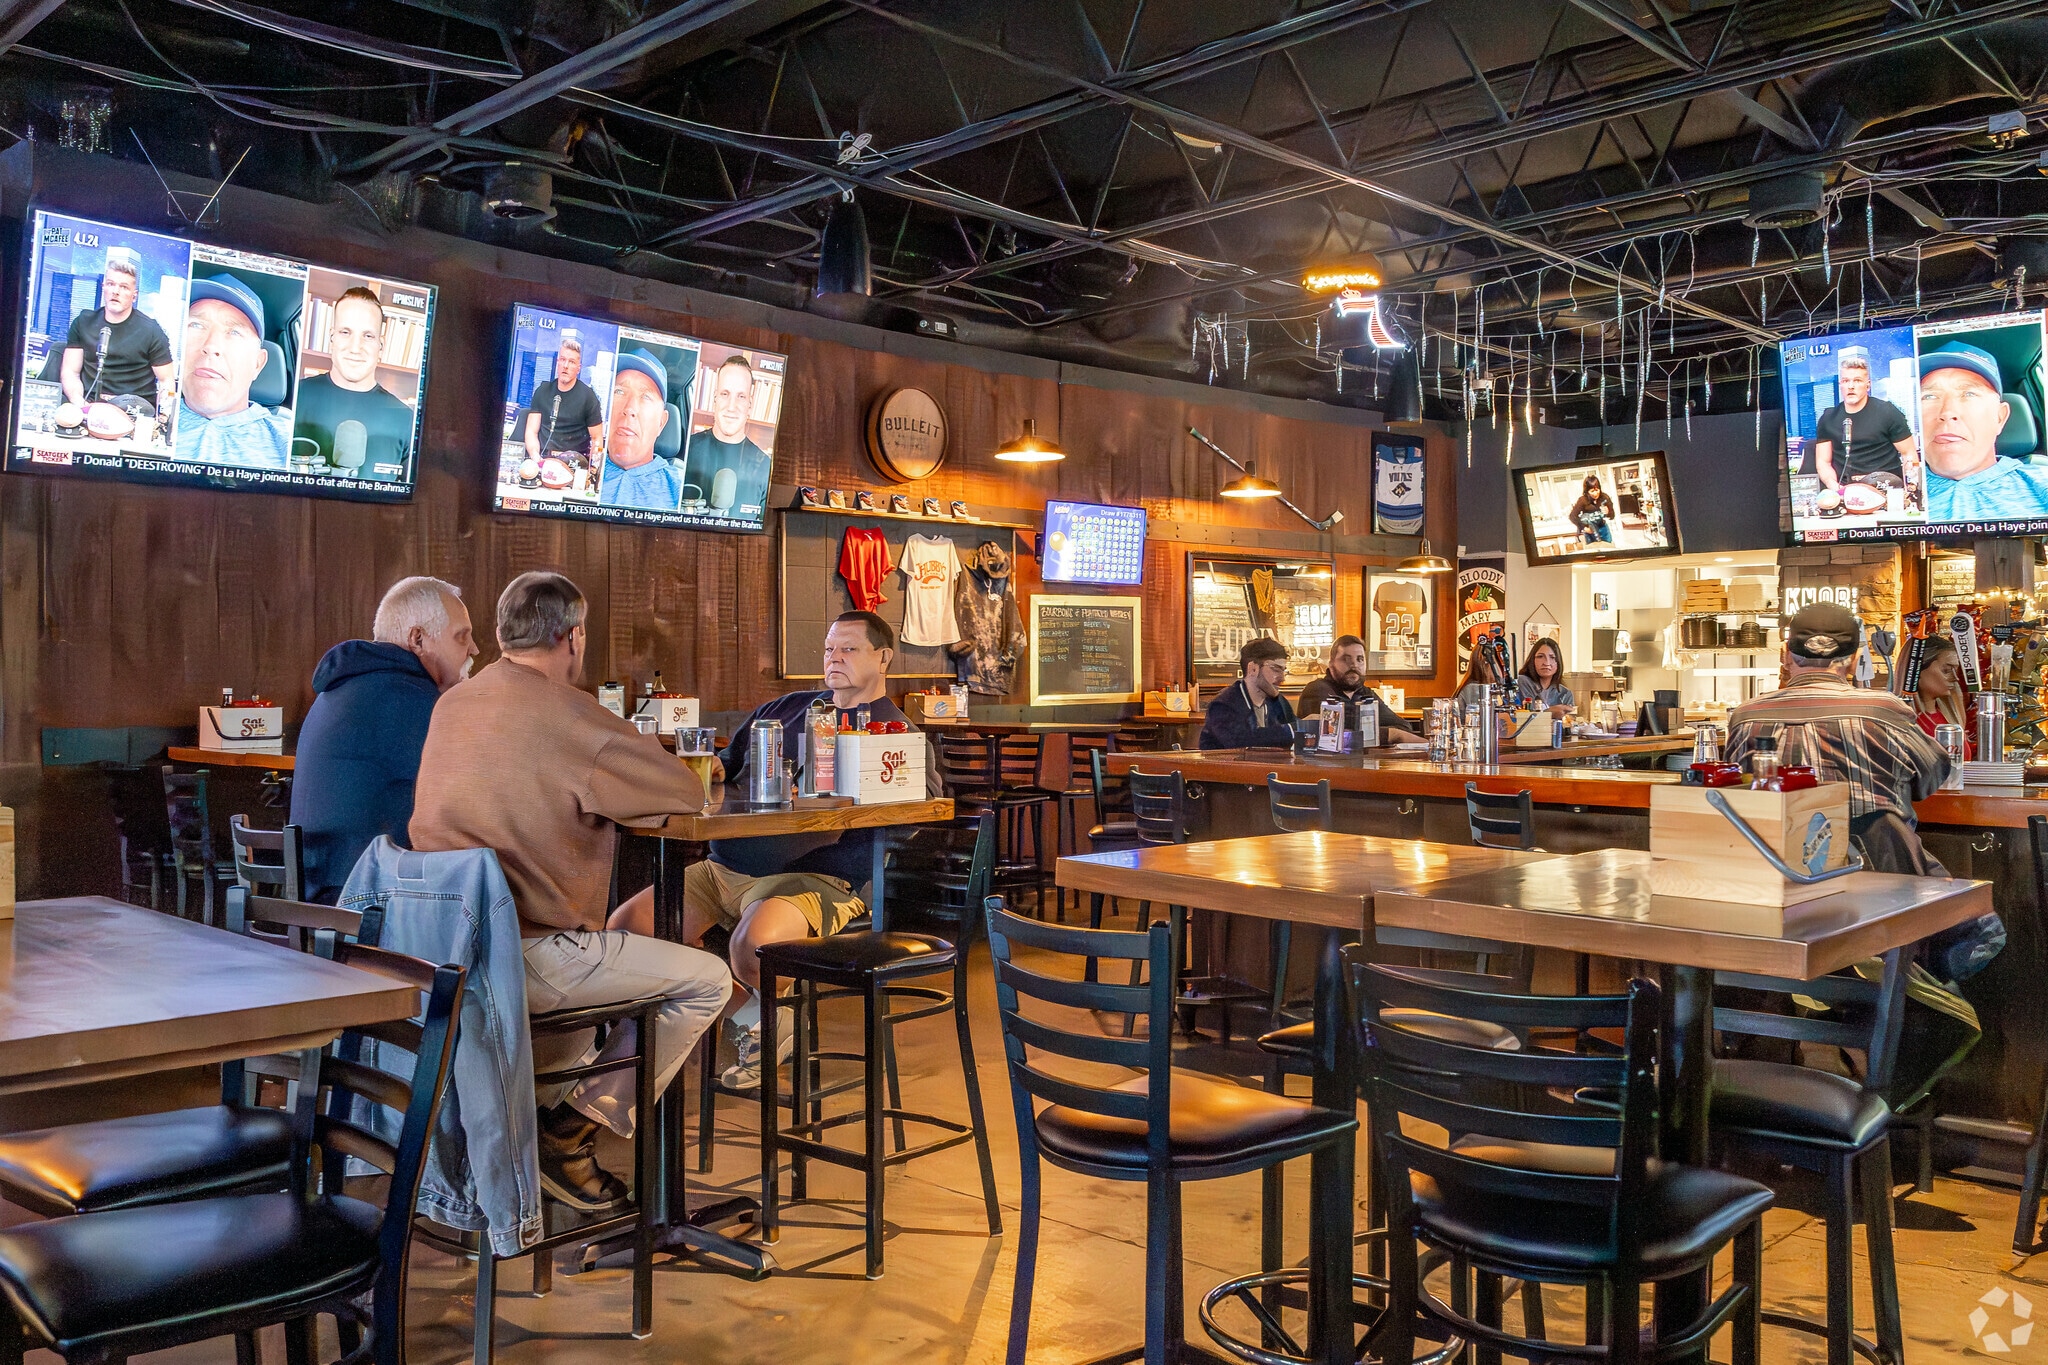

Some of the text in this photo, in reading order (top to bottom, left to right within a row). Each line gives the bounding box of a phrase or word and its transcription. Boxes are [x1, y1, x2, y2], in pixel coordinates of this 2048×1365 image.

[884, 416, 941, 439] BULLEIT
[36, 449, 69, 461] SEATGEEK
[83, 455, 123, 468] Donald
[206, 467, 221, 477] De
[223, 467, 235, 478] La
[236, 468, 261, 482] Haye
[260, 470, 291, 484] joined
[292, 475, 304, 484] us
[304, 475, 315, 485] to
[316, 475, 336, 487] chat
[336, 477, 358, 490] after
[358, 479, 373, 490] the
[373, 481, 411, 494] Brahma's
[539, 503, 566, 513] Donald
[623, 510, 635, 518] De
[634, 511, 643, 519] La
[643, 511, 661, 522] Haye
[660, 513, 682, 523] joined
[683, 516, 692, 524] us
[692, 516, 699, 525] to
[700, 517, 714, 526] chat
[714, 517, 730, 527] after
[729, 519, 741, 528] the
[1849, 527, 1884, 539] Donald
[1967, 523, 1982, 533] De
[1983, 522, 1997, 532] La
[1998, 521, 2027, 533] Haye
[1459, 569, 1504, 586] BLOODY
[1385, 612, 1415, 648] 22
[1460, 611, 1492, 631] MARY
[1957, 631, 1973, 669] SONDER
